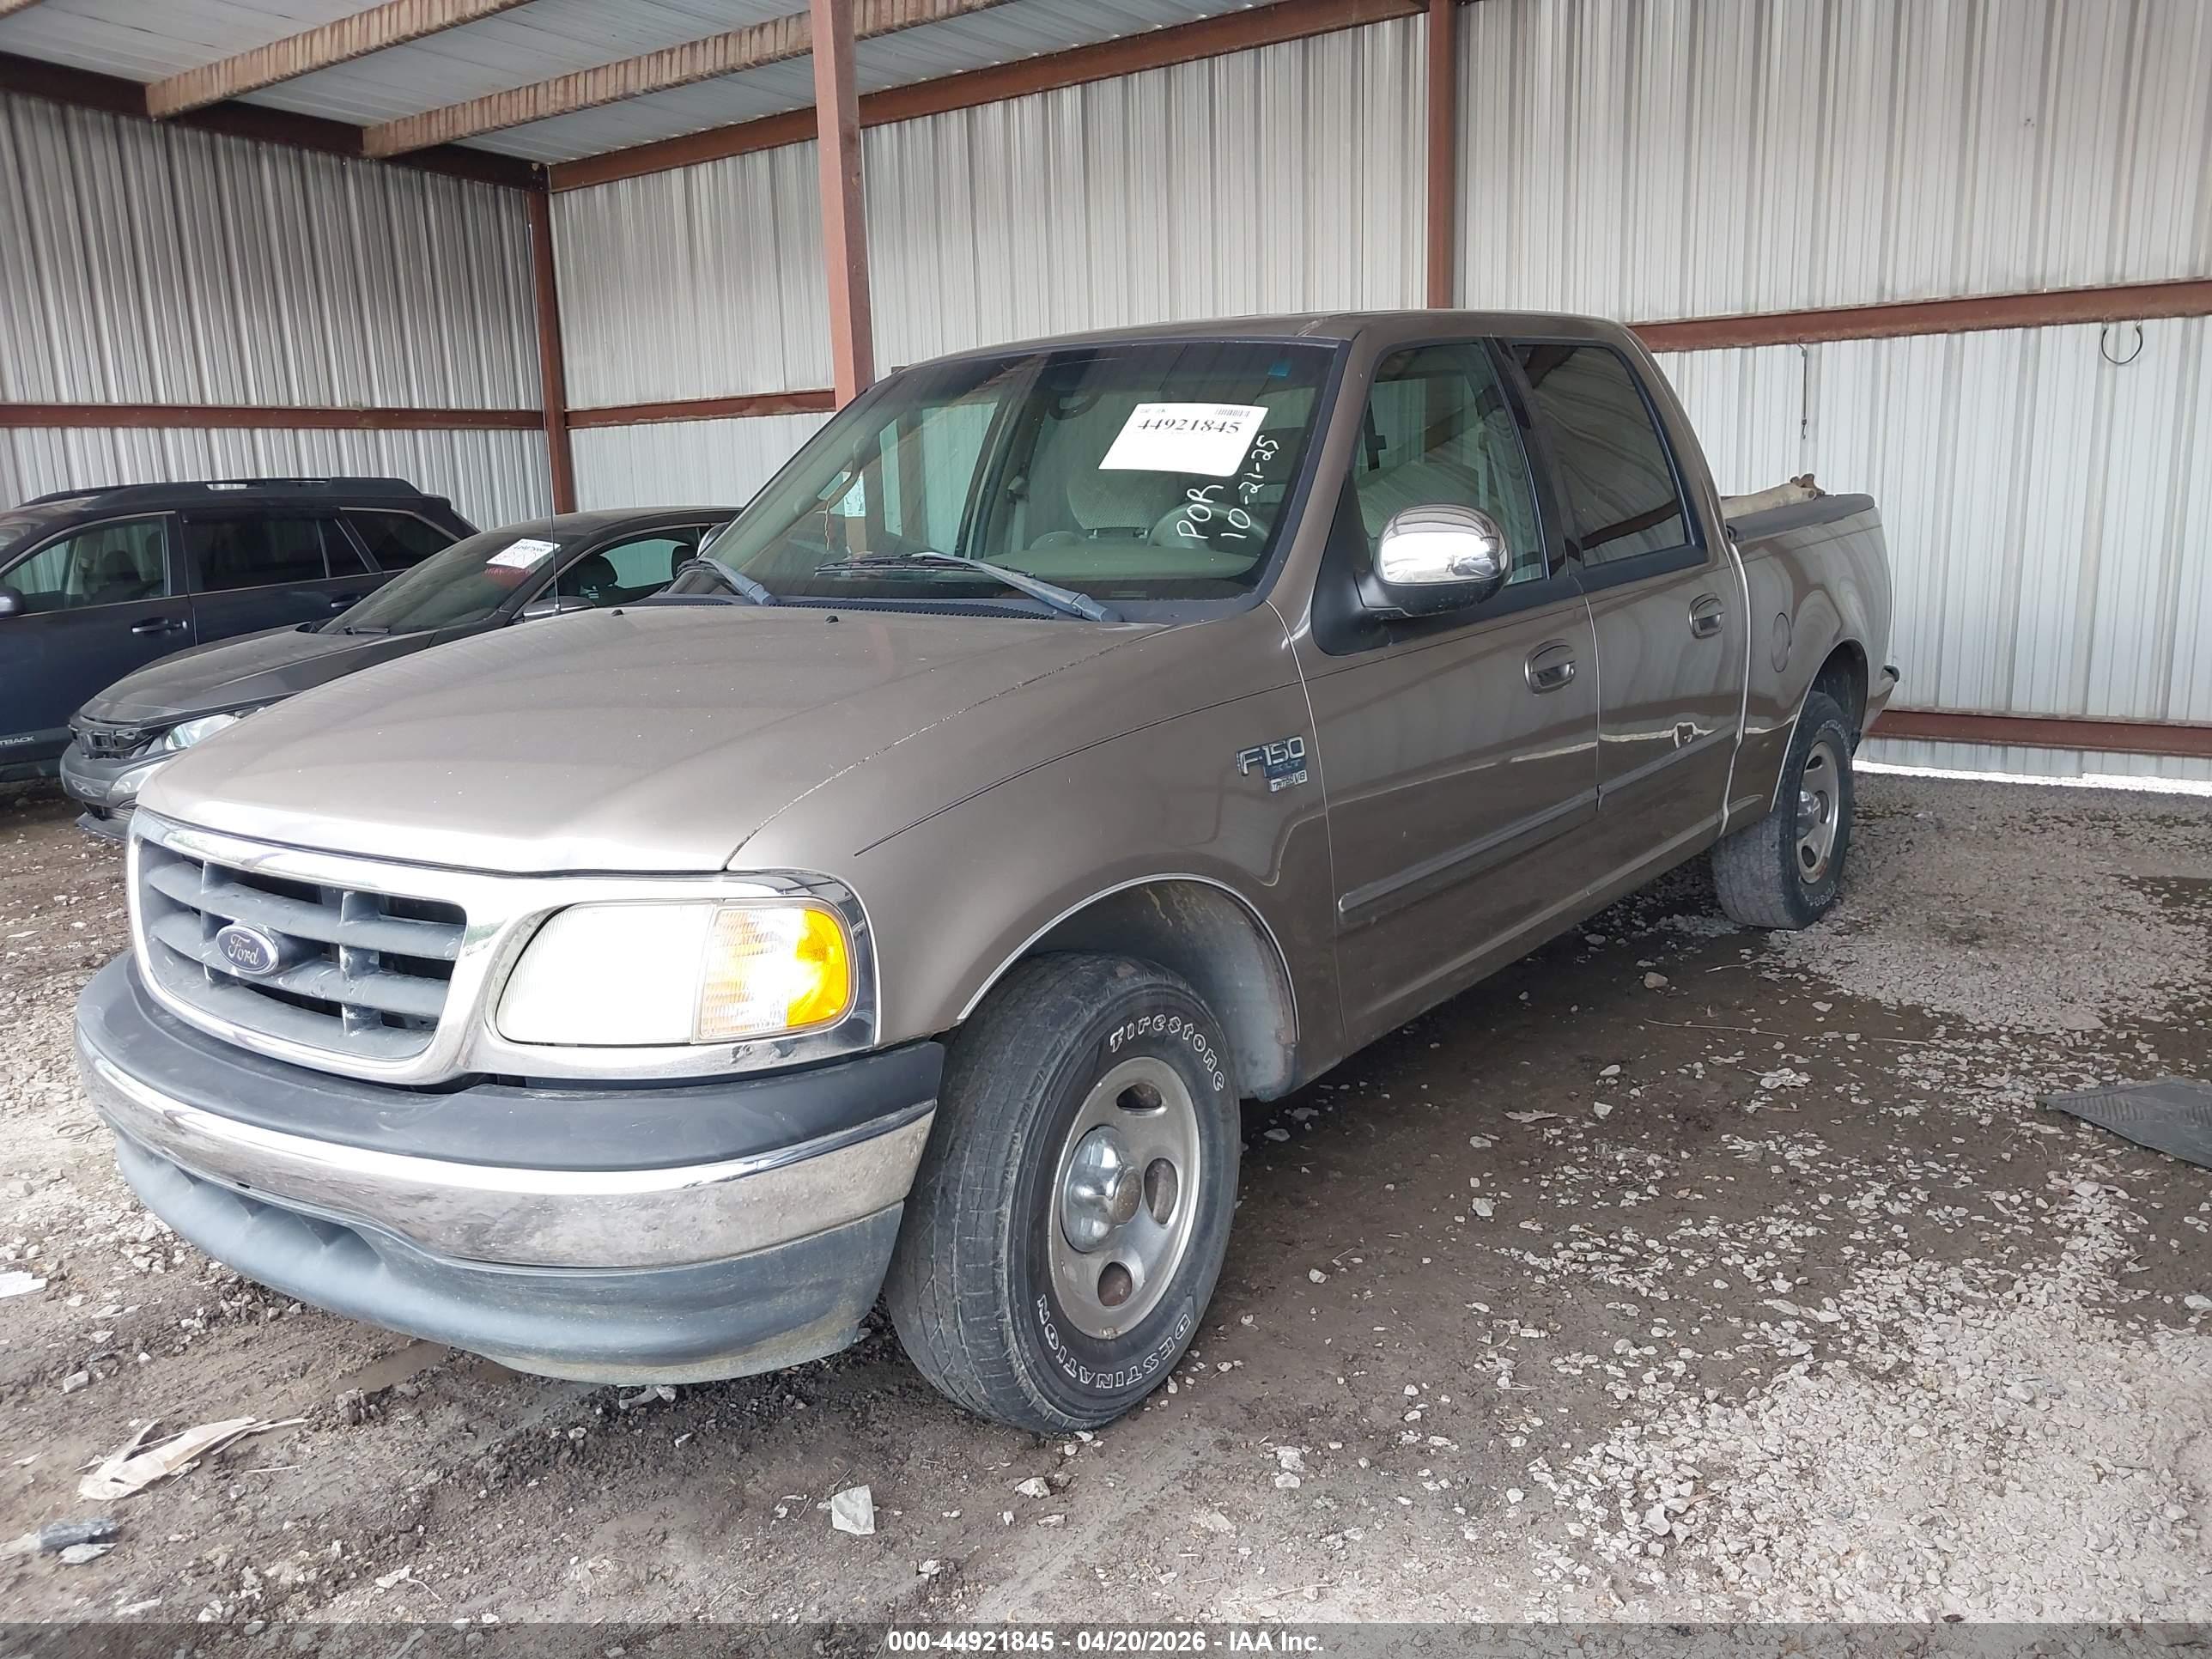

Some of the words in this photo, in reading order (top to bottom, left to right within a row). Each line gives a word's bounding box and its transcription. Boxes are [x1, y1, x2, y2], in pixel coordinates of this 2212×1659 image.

[1137, 417, 1243, 434] 44921845
[1220, 434, 1279, 538] 10-21-25
[228, 933, 259, 965] Ford
[1109, 1014, 1224, 1091] Firestone
[1037, 1293, 1191, 1389] DESTINATION
